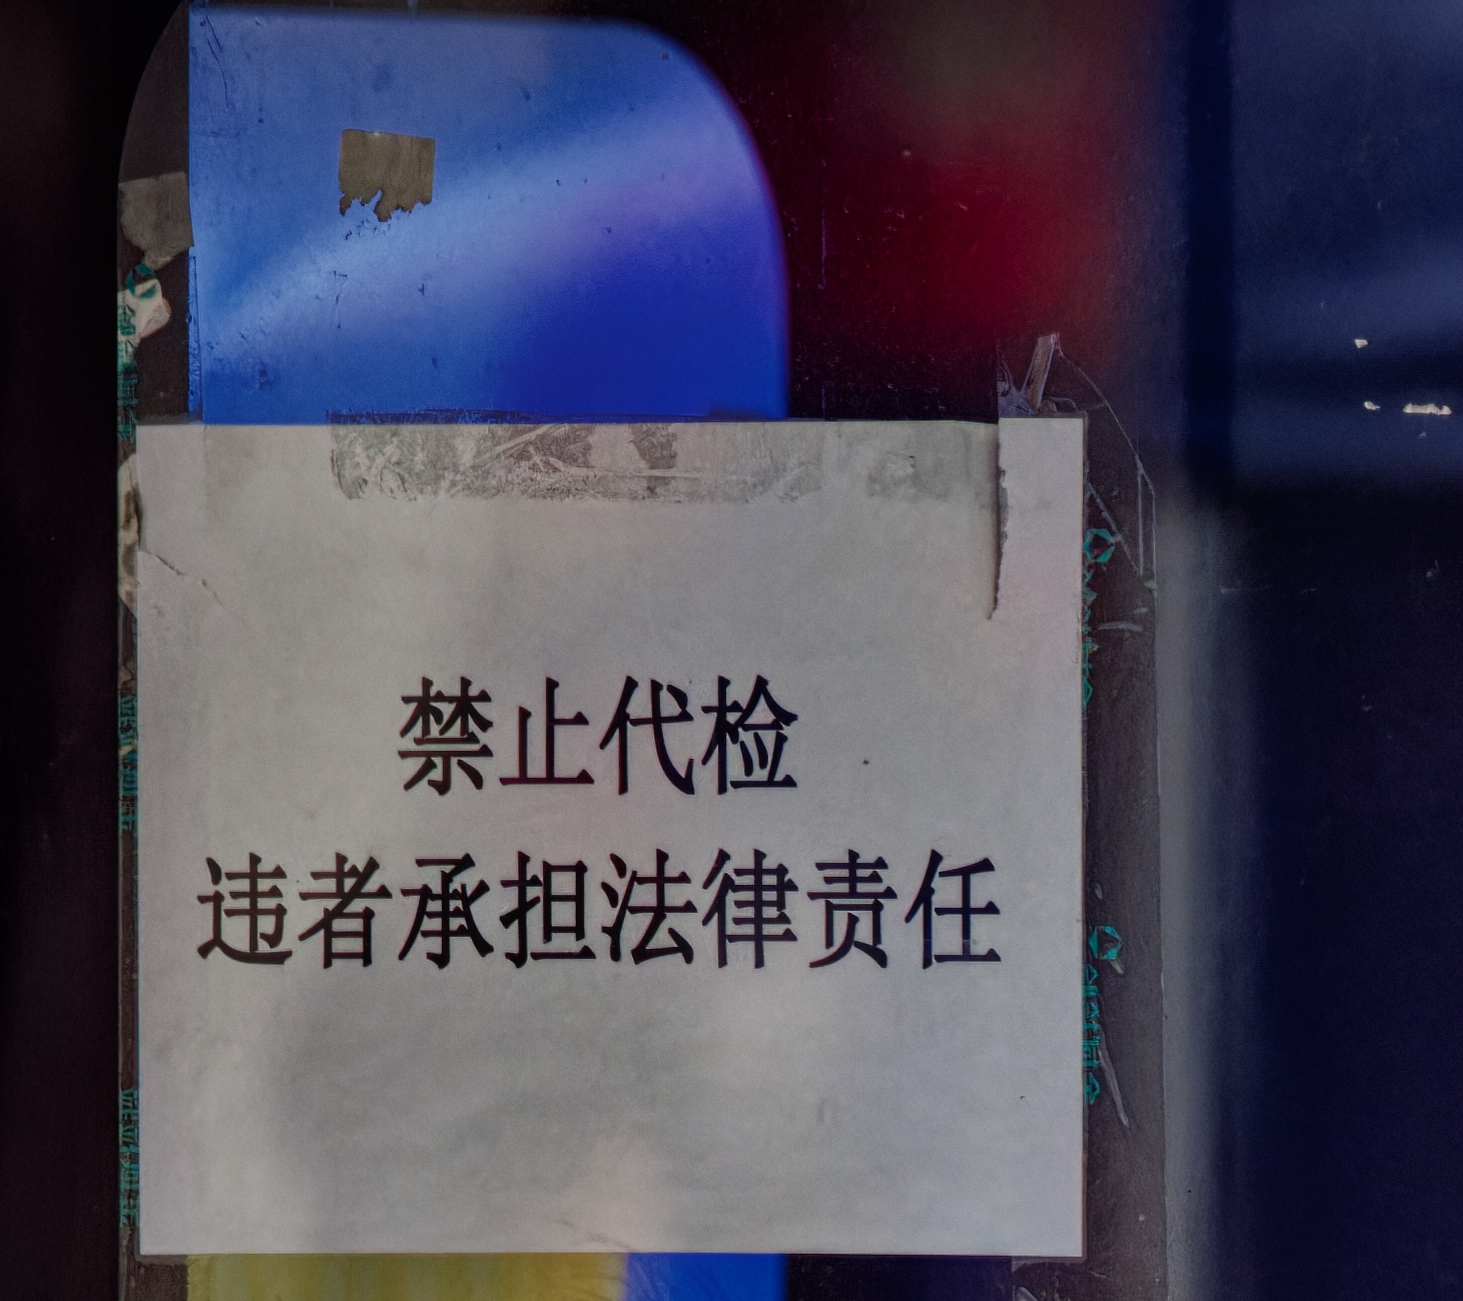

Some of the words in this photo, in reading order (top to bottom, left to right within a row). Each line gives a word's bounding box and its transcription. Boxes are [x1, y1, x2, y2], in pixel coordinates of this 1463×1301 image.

[396, 675, 799, 797] 禁止代检
[196, 848, 1003, 970] 违者承担法律责任
